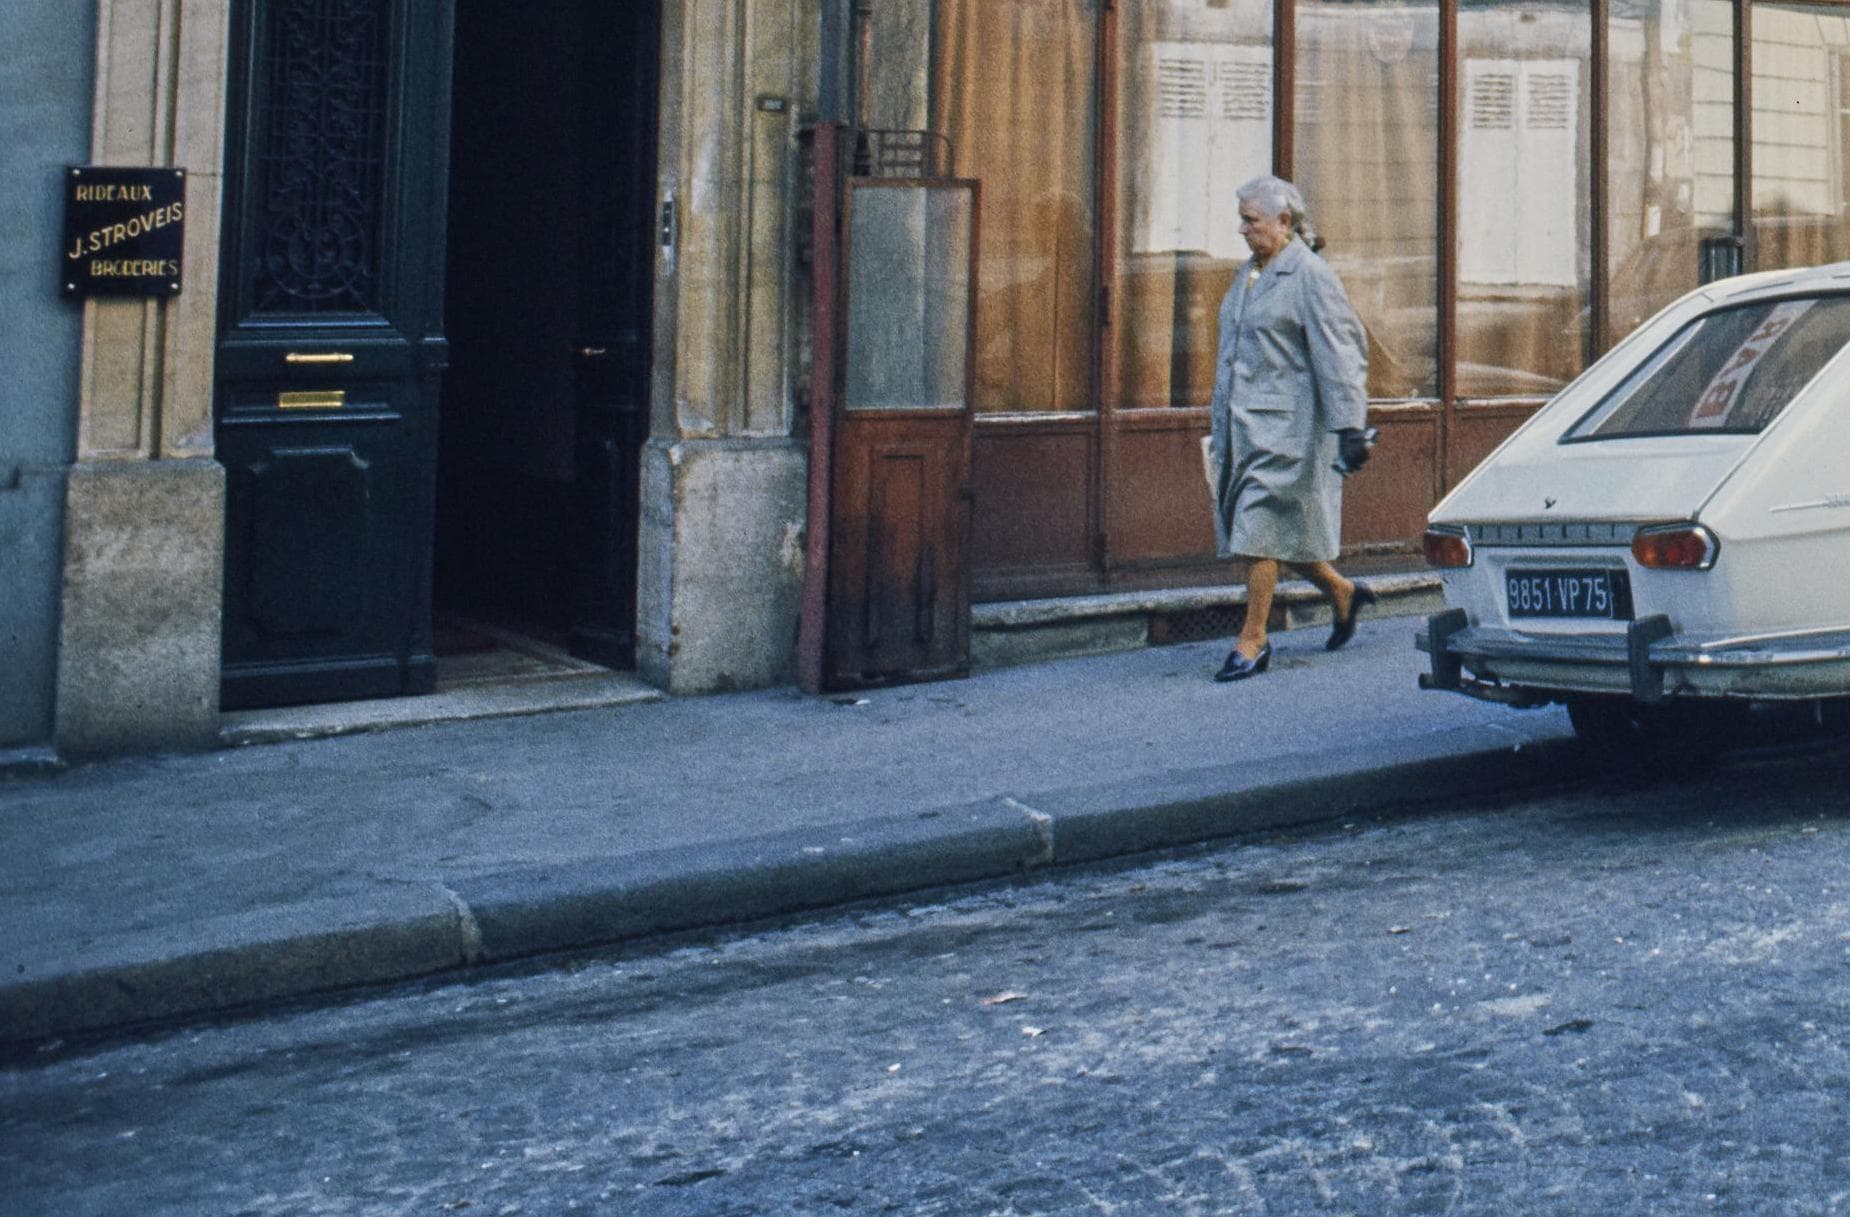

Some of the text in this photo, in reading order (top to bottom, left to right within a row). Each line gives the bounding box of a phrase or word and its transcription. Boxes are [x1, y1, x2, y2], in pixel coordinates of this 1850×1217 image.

[75, 184, 153, 202] RIDEAUX
[90, 259, 179, 277] BRODERIES
[1508, 577, 1607, 611] 9851 VP 75
